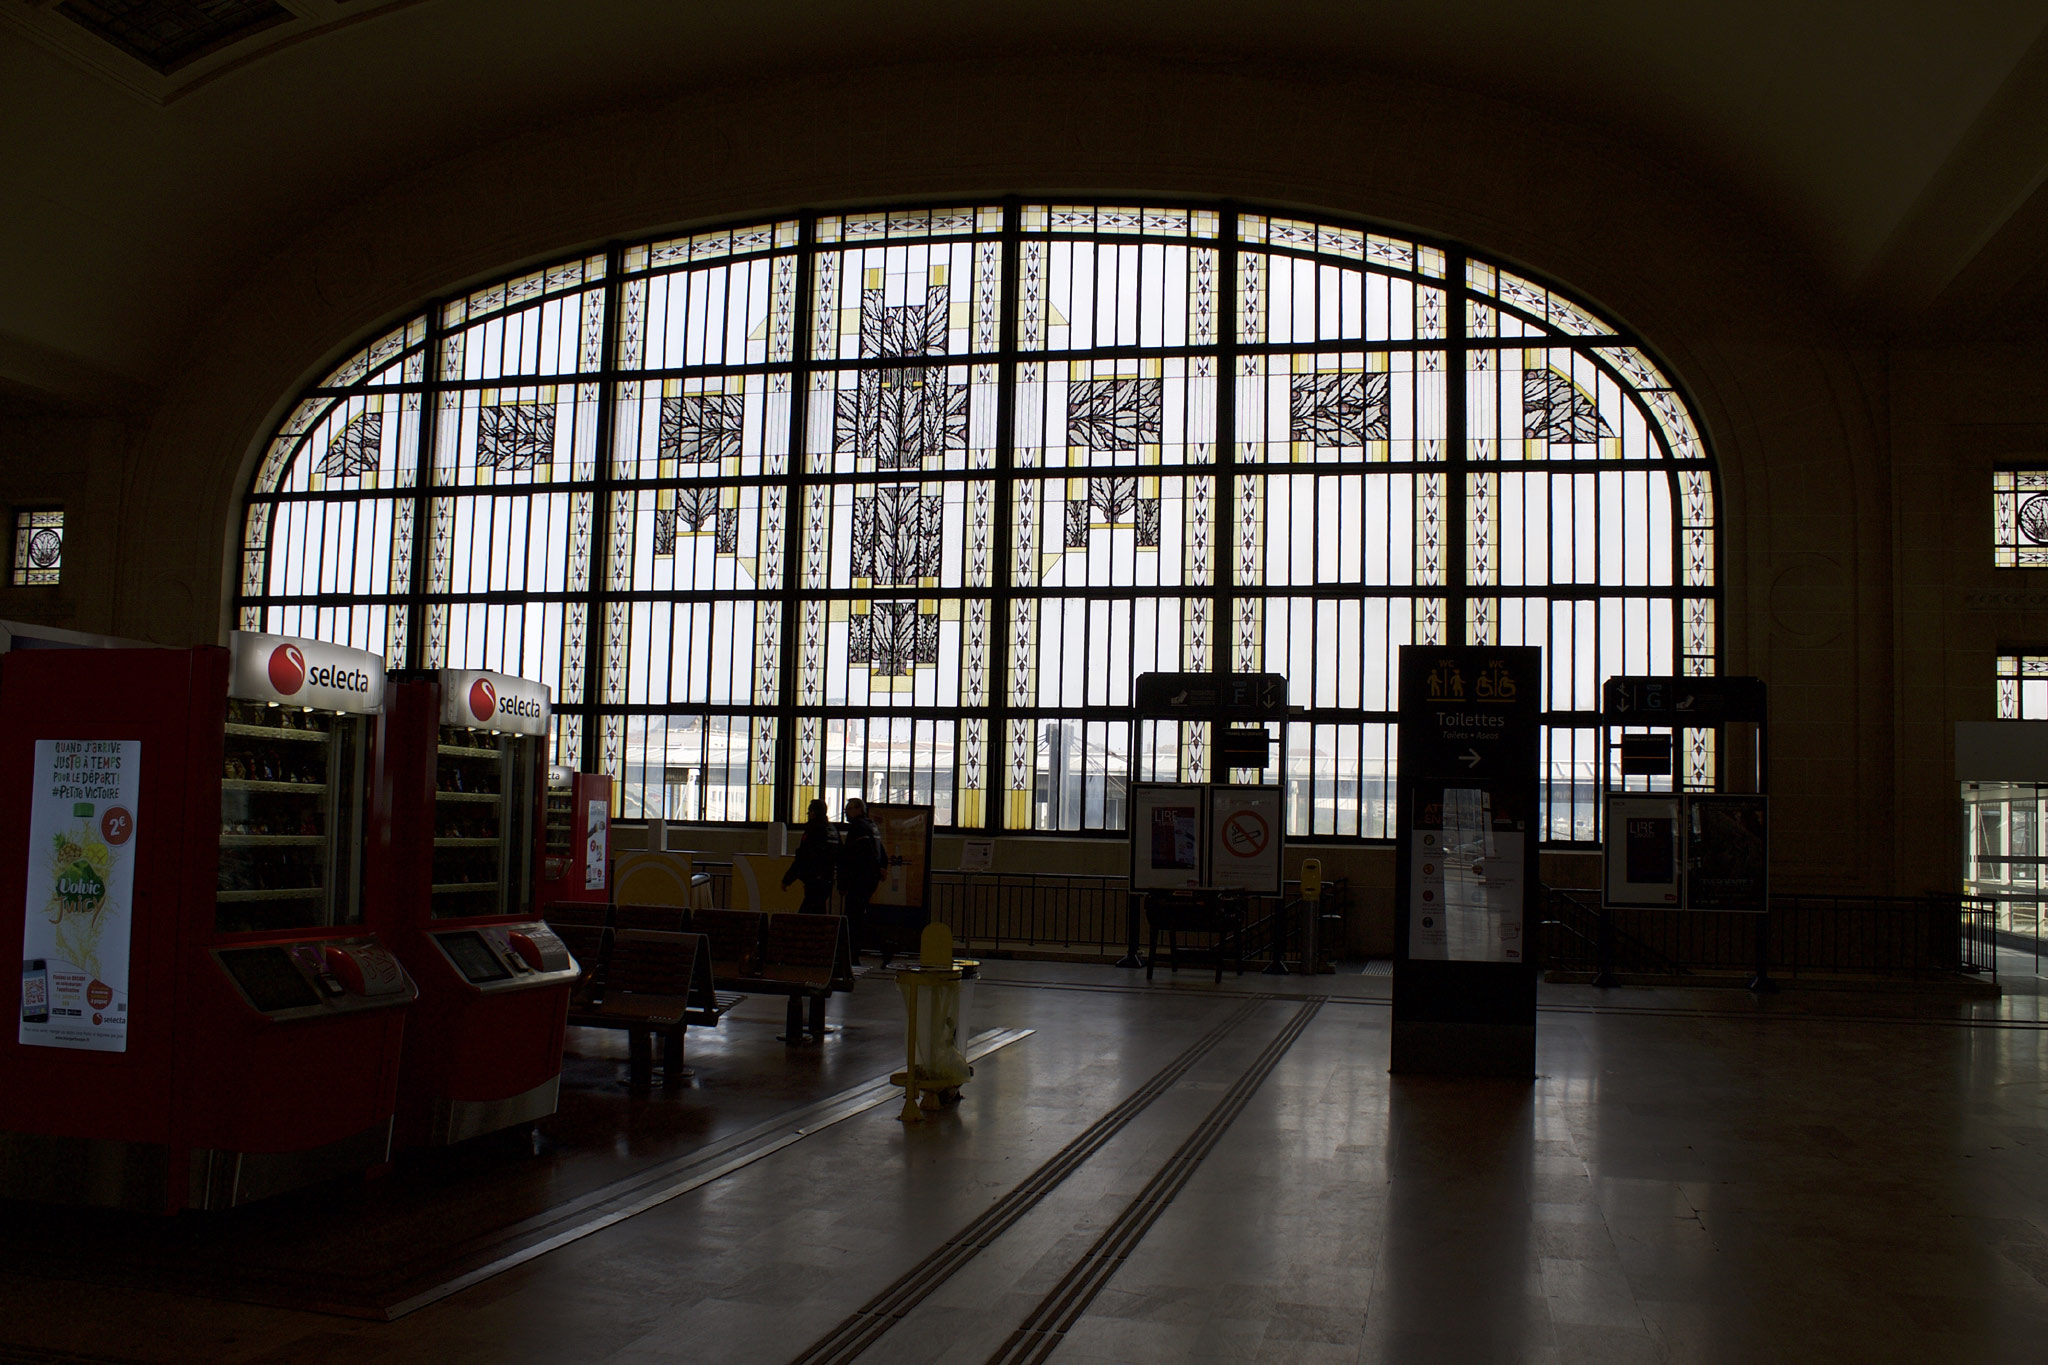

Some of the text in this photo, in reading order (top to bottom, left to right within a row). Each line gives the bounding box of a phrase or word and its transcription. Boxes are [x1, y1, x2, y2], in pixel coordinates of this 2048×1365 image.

[308, 665, 369, 694] selecta
[1233, 688, 1246, 704] F
[1647, 692, 1662, 708] G
[498, 695, 541, 719] selecta
[1436, 711, 1505, 727] Toilettes
[1442, 731, 1468, 740] Toilets
[55, 742, 82, 753] QUAND
[91, 756, 121, 769] TEMPS
[72, 773, 81, 783] LE
[59, 878, 101, 895] Volvic
[103, 1017, 126, 1025] selecta
